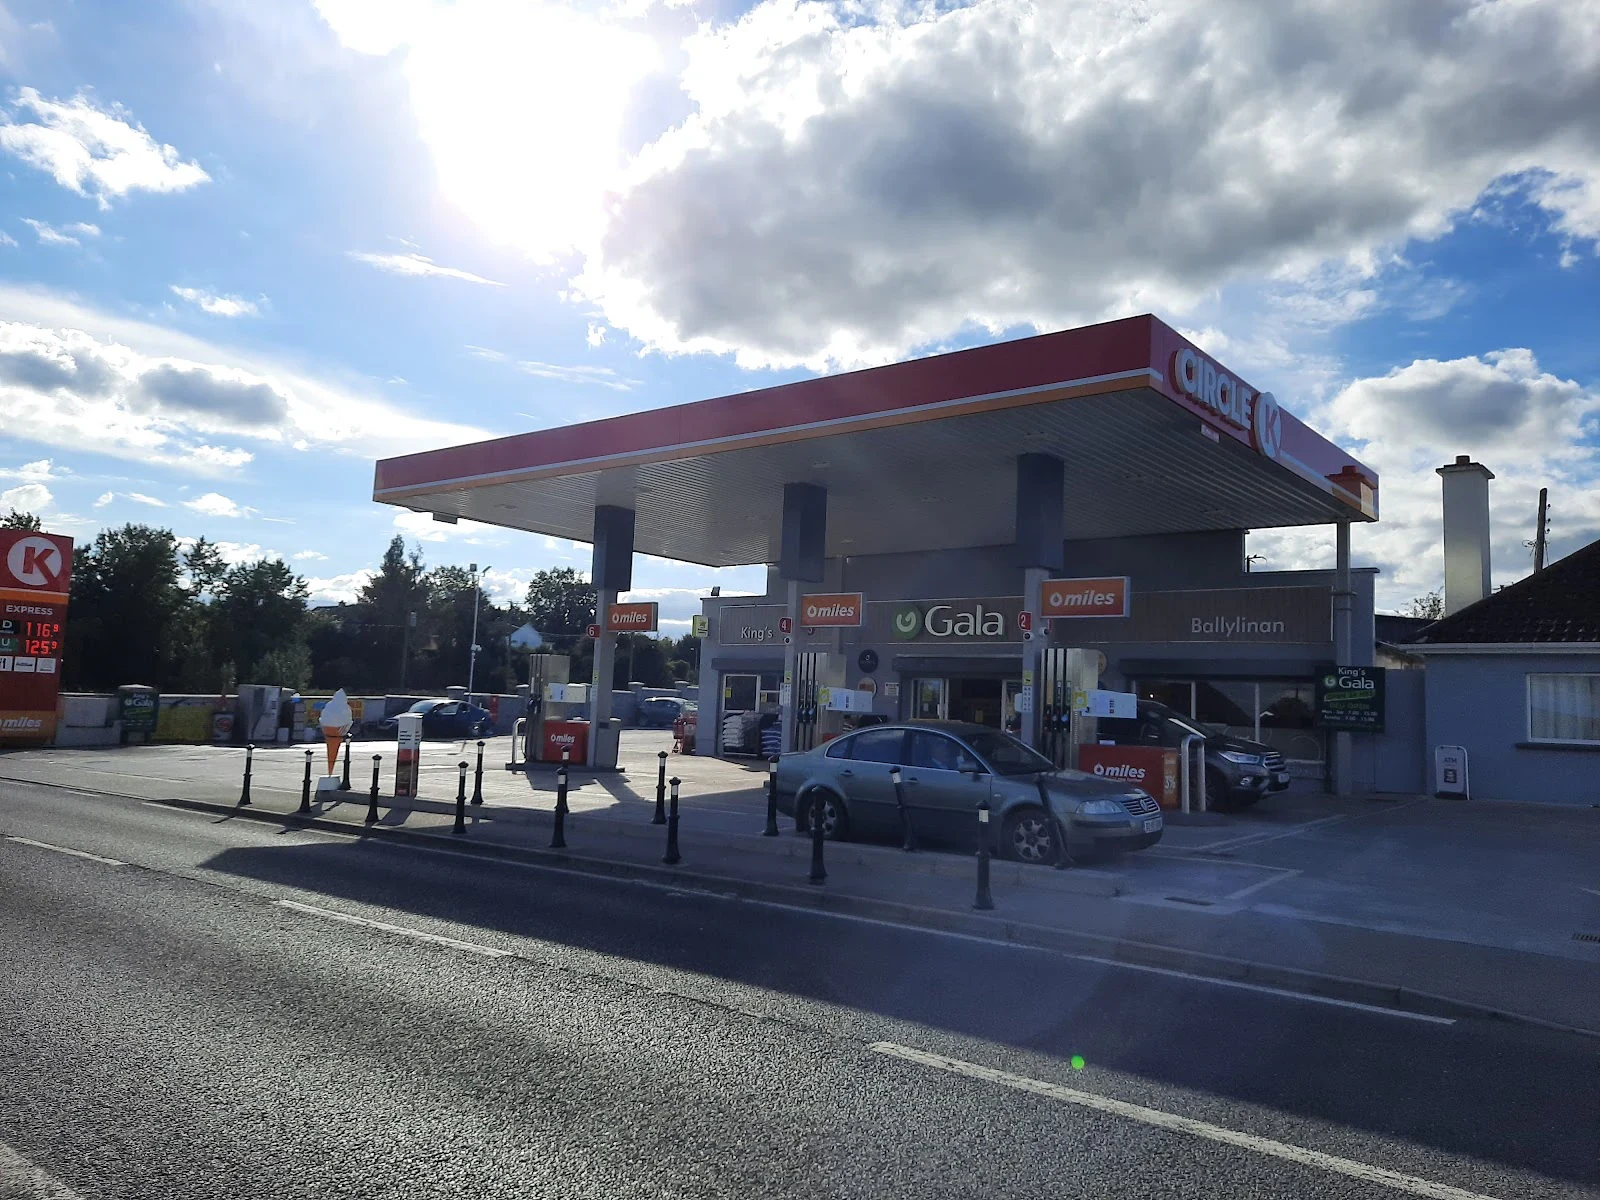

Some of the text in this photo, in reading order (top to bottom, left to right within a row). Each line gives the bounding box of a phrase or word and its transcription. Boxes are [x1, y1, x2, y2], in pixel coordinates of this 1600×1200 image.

[1178, 348, 1282, 457] CIRCLE K
[21, 545, 59, 586] K
[1063, 589, 1116, 606] miles
[5, 604, 54, 616] EXPRESS
[817, 604, 855, 618] miles
[619, 611, 648, 624] miles
[924, 604, 1004, 636] Gala
[1021, 614, 1027, 628] 2
[2, 620, 13, 629] D
[781, 620, 787, 631] 4
[1191, 616, 1285, 637] Ballylinan
[589, 626, 596, 637] 6
[741, 626, 773, 642] King's
[1, 638, 11, 646] U
[1338, 667, 1366, 678] King's
[1338, 676, 1375, 689] Gala
[4, 716, 42, 728] miles
[556, 734, 576, 743] miles
[1105, 764, 1146, 779] miles
